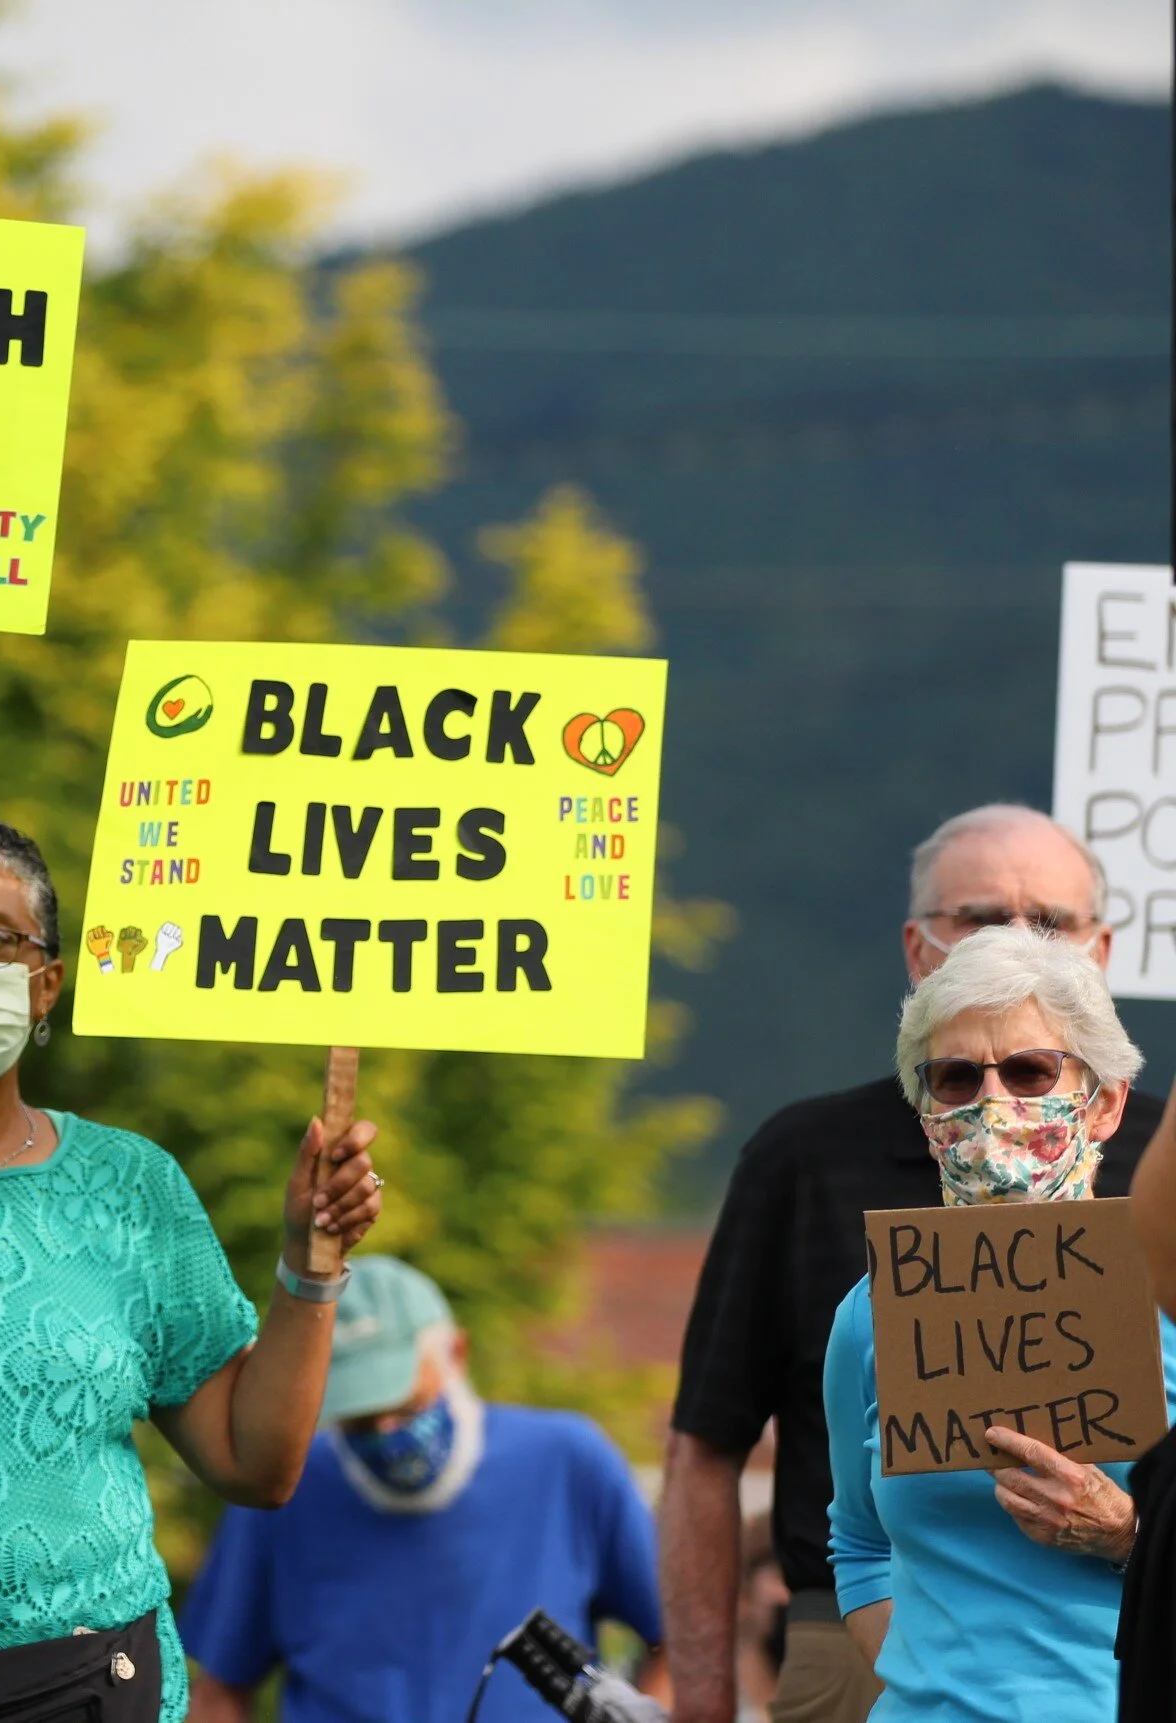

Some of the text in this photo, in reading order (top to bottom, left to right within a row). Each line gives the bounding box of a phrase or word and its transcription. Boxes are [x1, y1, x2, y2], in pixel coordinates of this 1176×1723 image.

[241, 679, 541, 765] BLACK
[119, 779, 211, 808] UNITED
[559, 796, 639, 823] PEACE
[138, 821, 179, 847] WE
[248, 801, 507, 881] LIVES
[574, 833, 625, 860] AND
[120, 858, 200, 885] STAND
[564, 874, 630, 900] LOVE
[195, 914, 552, 993] MATTER
[889, 1223, 1104, 1297] BLACK
[914, 1311, 1095, 1380] LIVES
[885, 1389, 1136, 1467] MATTER
